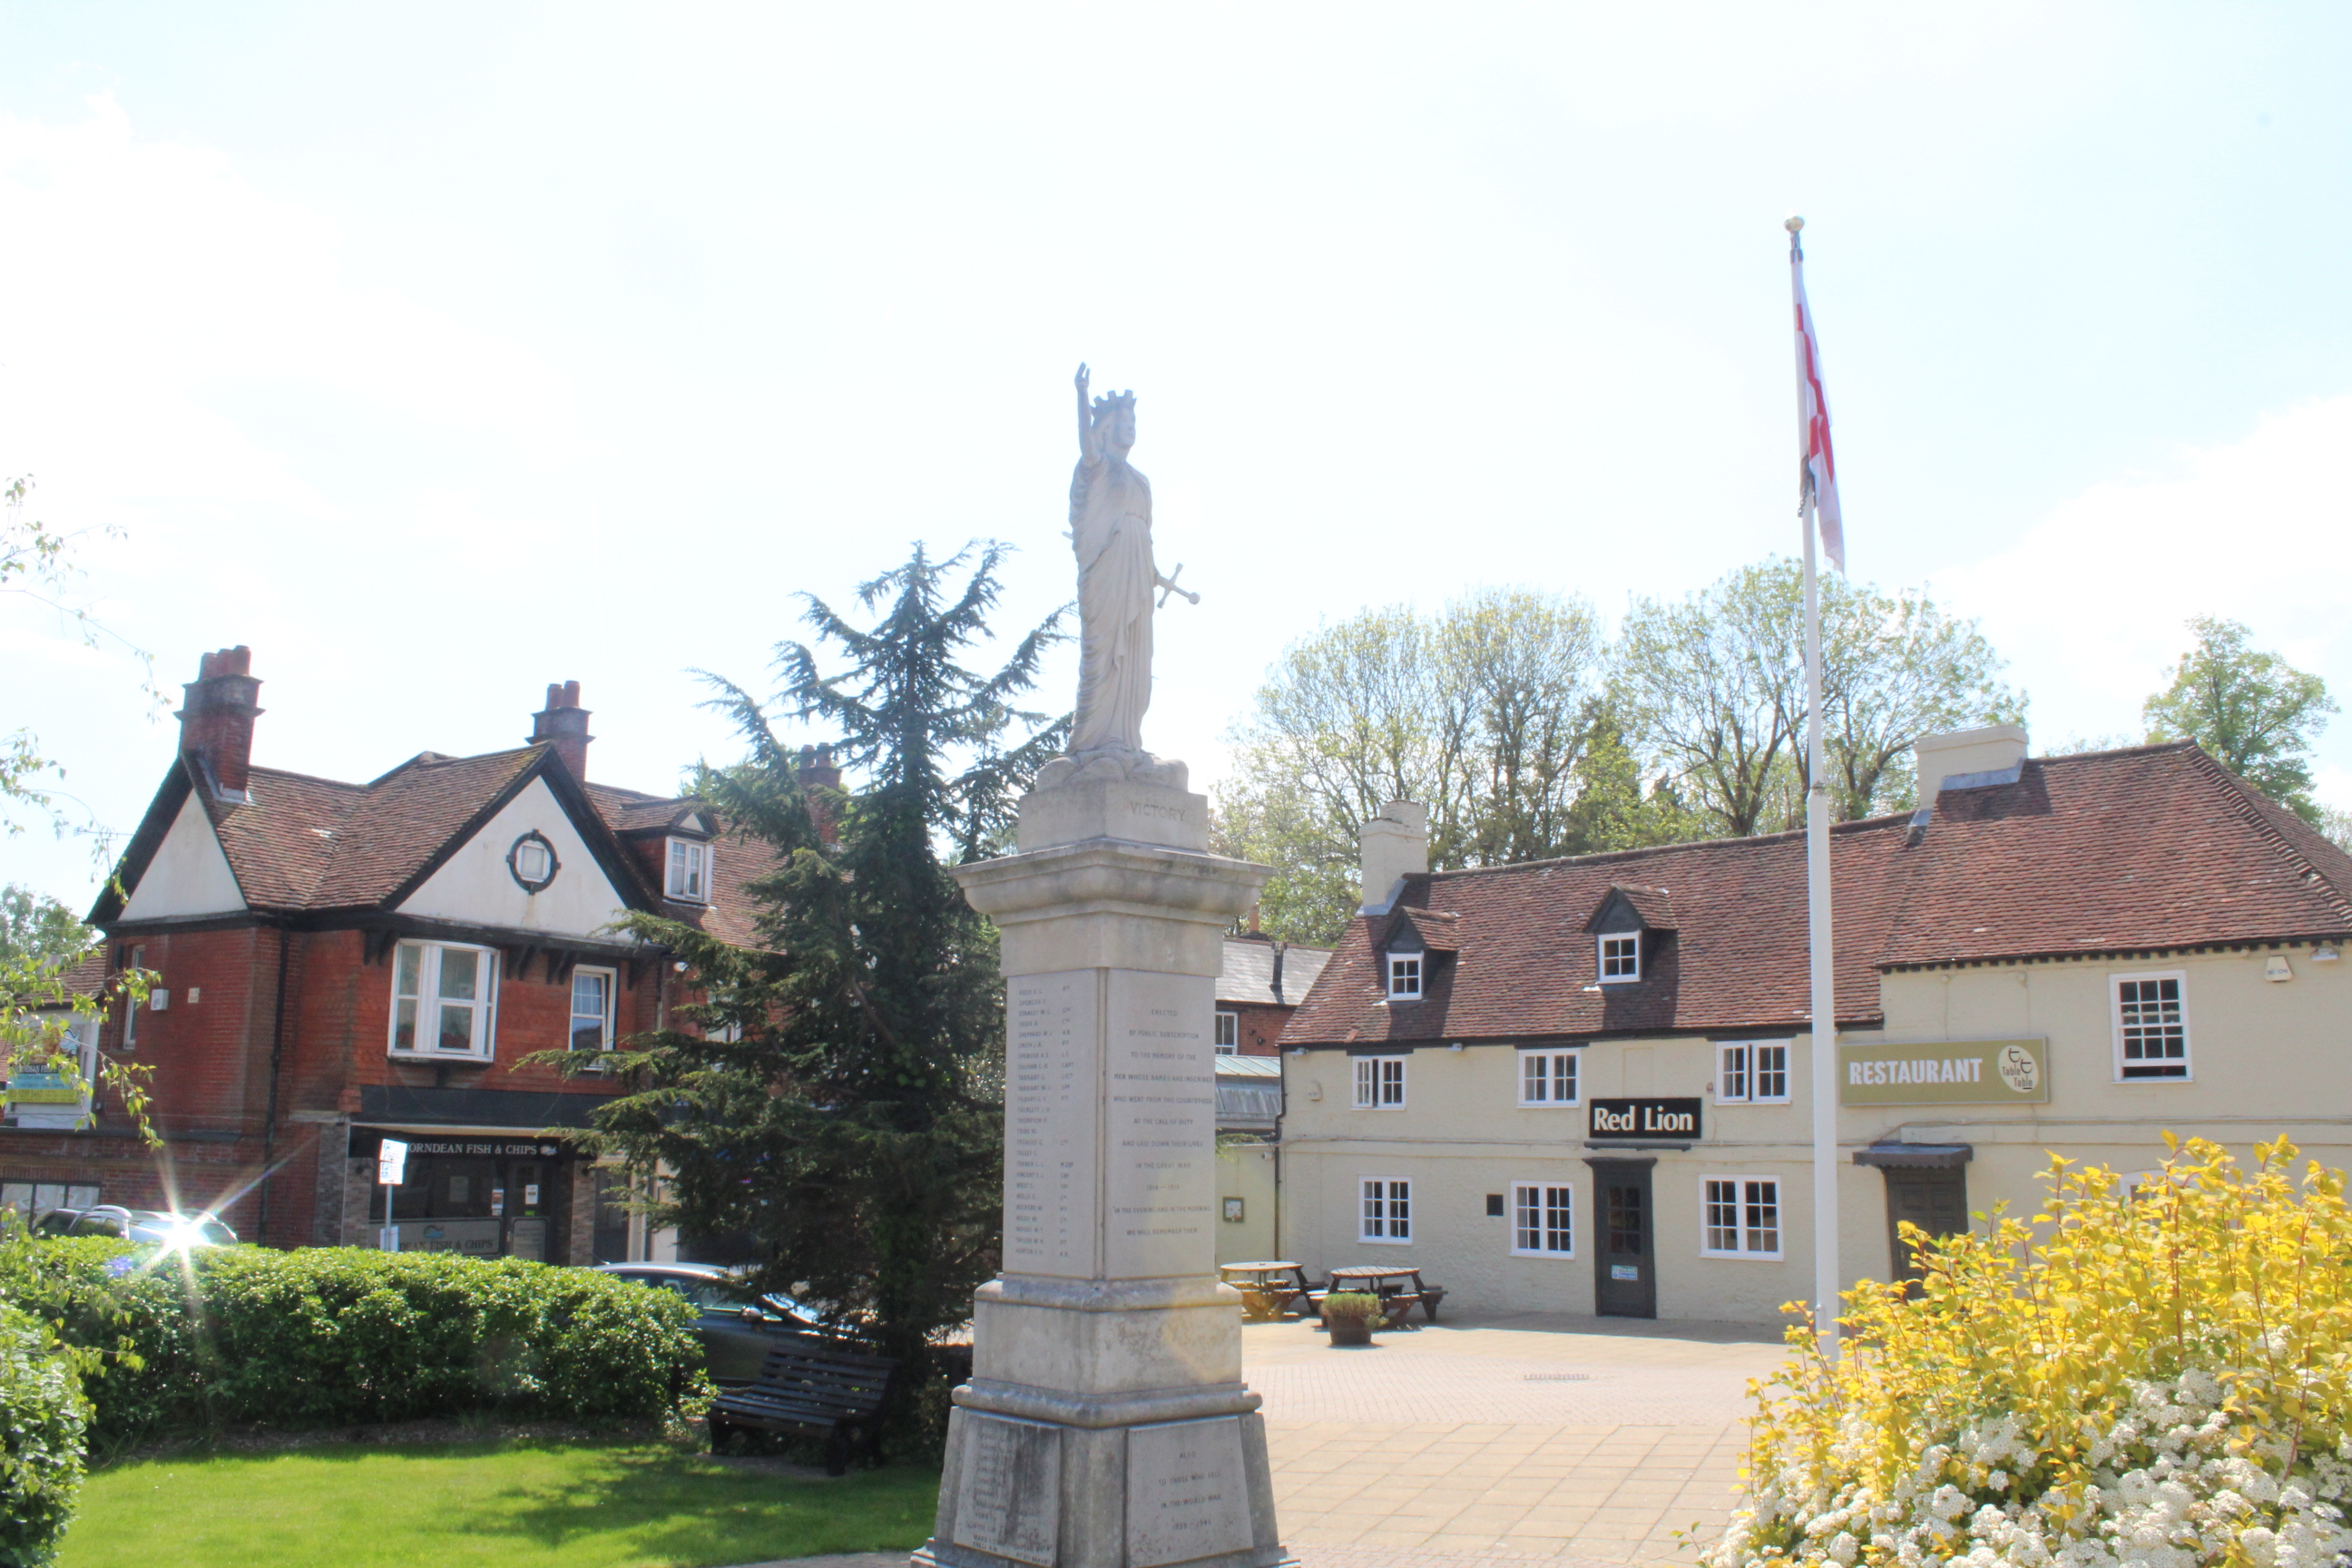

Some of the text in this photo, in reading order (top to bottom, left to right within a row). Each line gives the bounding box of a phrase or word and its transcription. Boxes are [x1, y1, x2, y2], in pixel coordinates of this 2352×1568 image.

[1130, 801, 1186, 821] VICTORY
[1152, 1008, 1178, 1016] ERECTED
[1160, 1031, 1199, 1039] SUBSCRIPTION
[1152, 1052, 1175, 1060] MEMORY
[1849, 1058, 1983, 1085] RESTAURANT
[2002, 1063, 2021, 1075] Table
[2014, 1076, 2033, 1087] Table
[1593, 1105, 1693, 1132] Red Lion
[466, 1143, 491, 1154] FISH
[495, 1144, 502, 1154] &
[505, 1144, 537, 1155] CHIPS
[430, 1240, 452, 1250] FISH
[465, 1239, 493, 1249] CHIPS
[1179, 1451, 1196, 1459] ALSO
[1170, 1475, 1188, 1484] THOSE
[1191, 1473, 1205, 1481] WHO
[1182, 1496, 1206, 1505] WORLD
[1208, 1494, 1221, 1502] WAR
